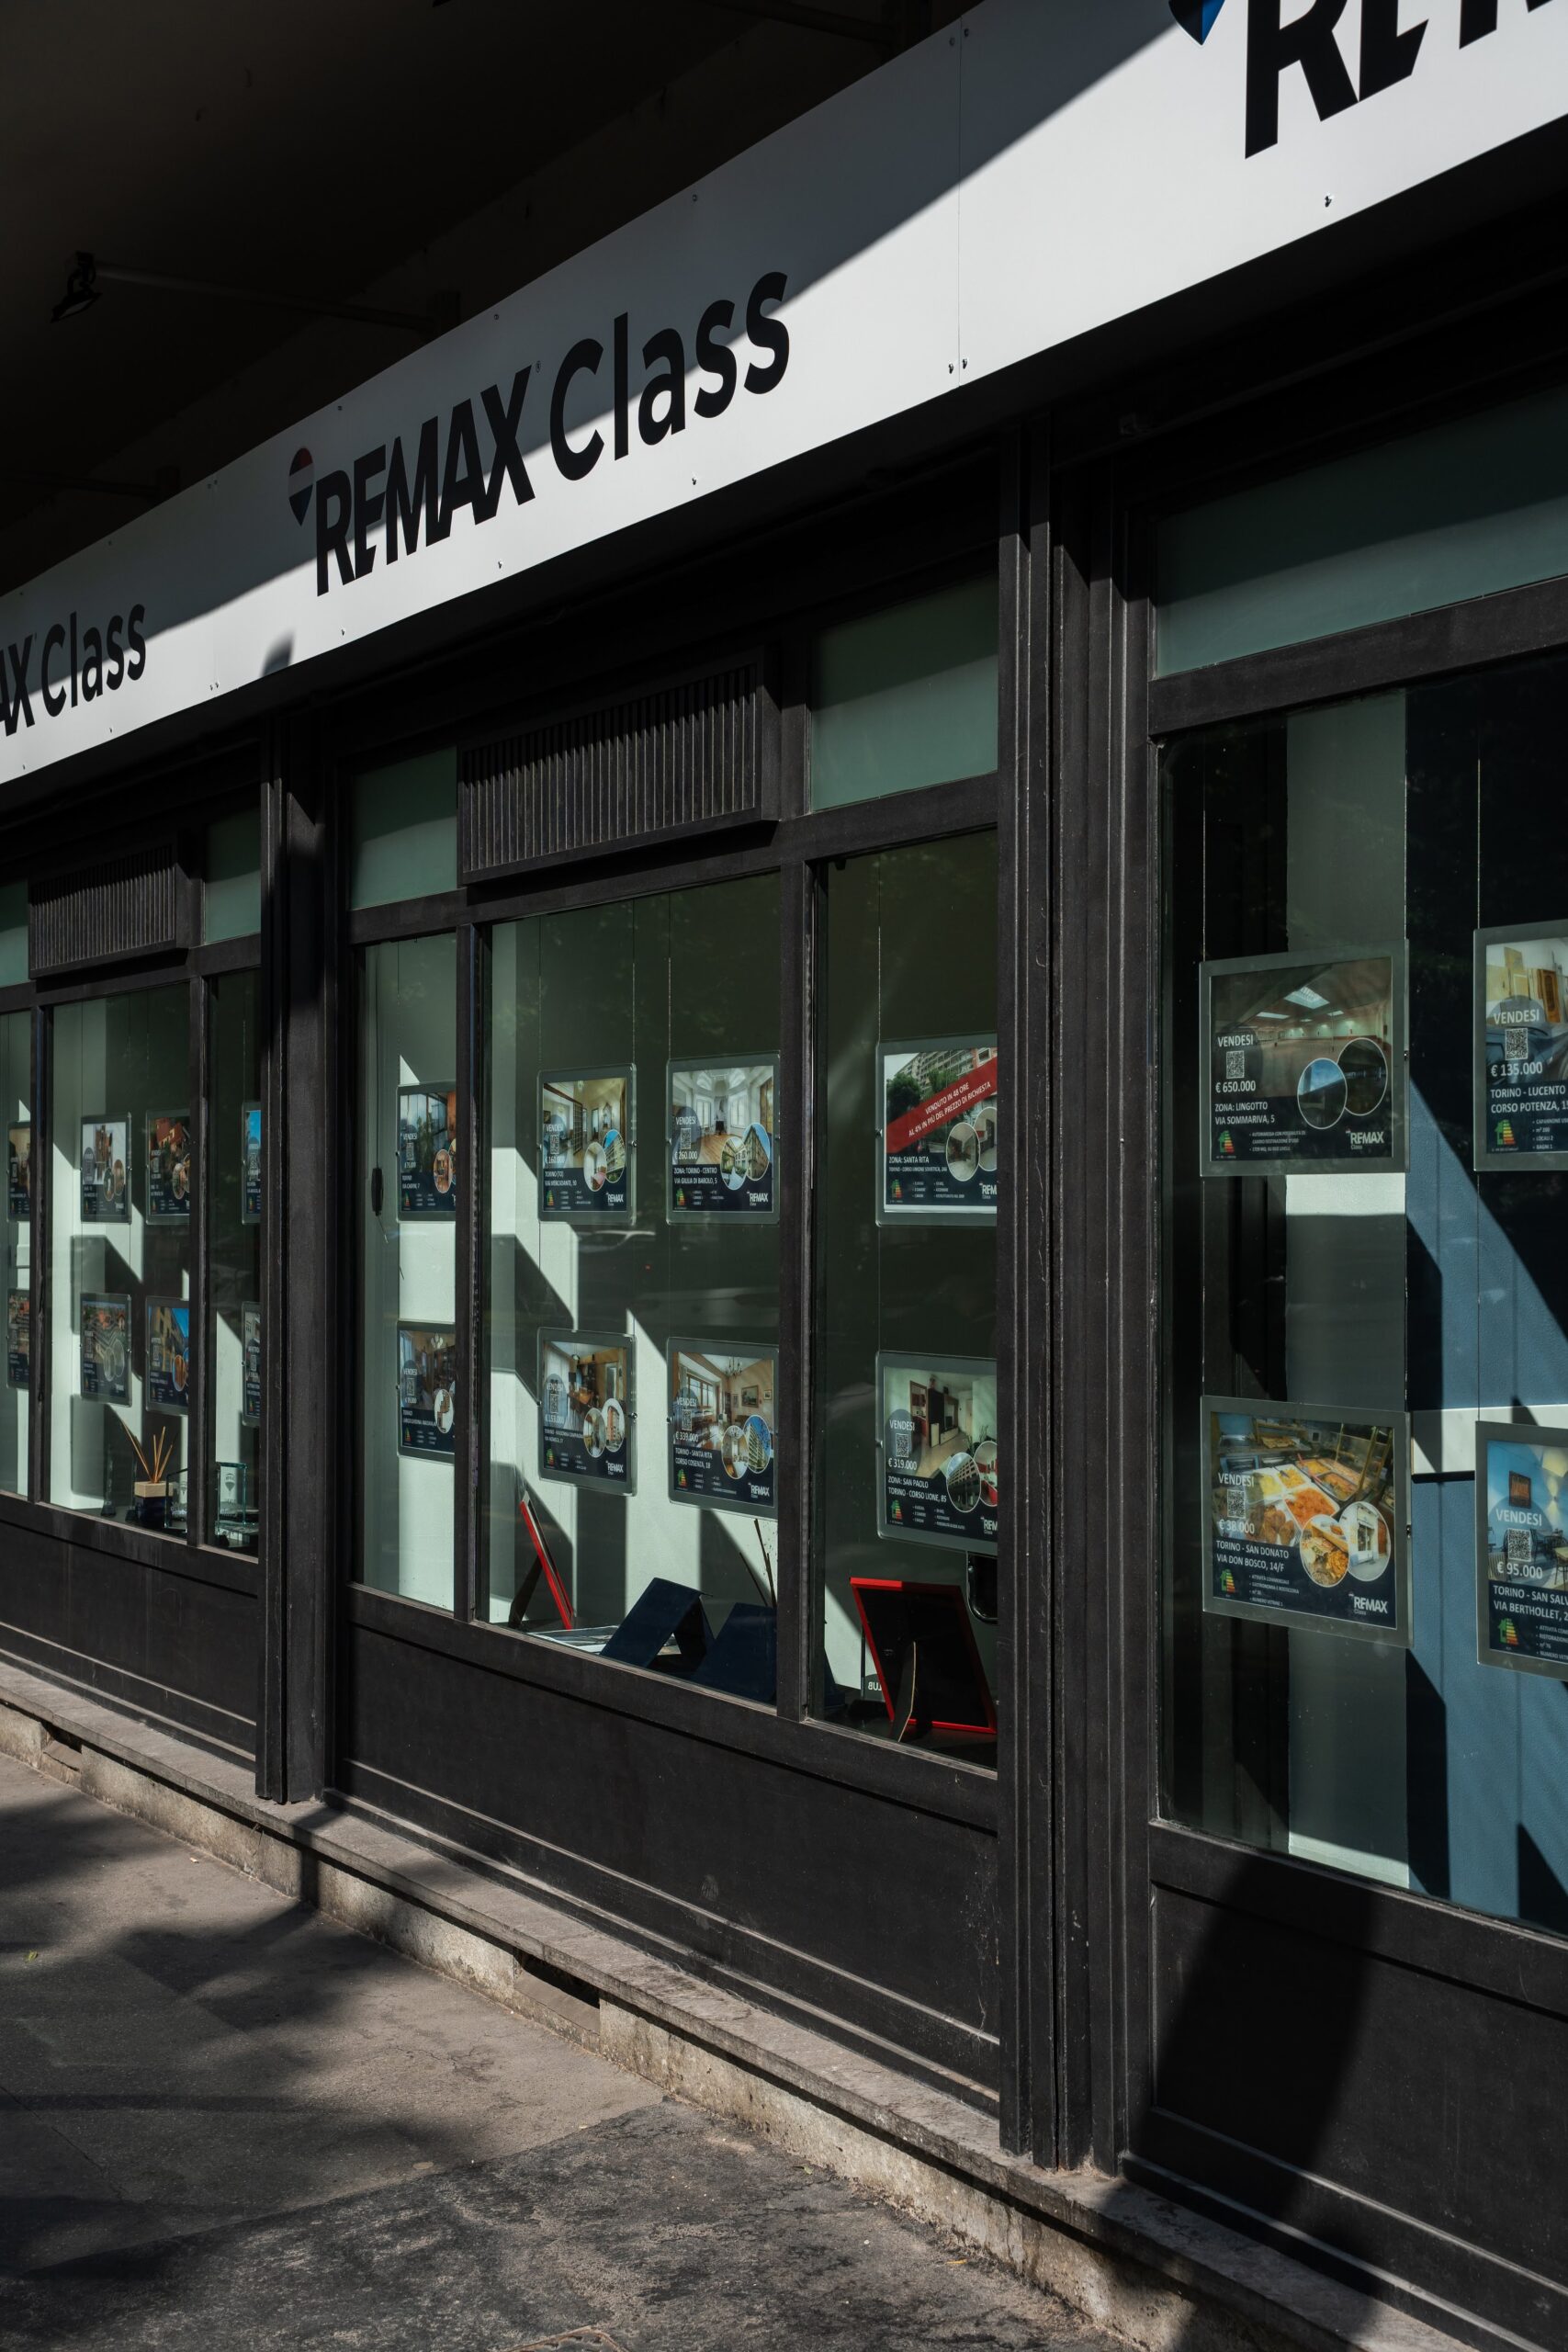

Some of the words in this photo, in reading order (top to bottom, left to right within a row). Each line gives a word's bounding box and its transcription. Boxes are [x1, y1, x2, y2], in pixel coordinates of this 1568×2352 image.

[316, 365, 536, 596] REMAX
[551, 272, 791, 481] Class
[41, 604, 146, 717] Class
[1494, 1010, 1540, 1024] VENDESI
[1217, 1035, 1253, 1047] VENDESI
[1491, 1065, 1498, 1077] €
[1500, 1062, 1543, 1077] 135.000
[1215, 1082, 1222, 1093] €
[1223, 1080, 1256, 1092] 650.000
[1490, 1088, 1521, 1099] TORINO
[1528, 1085, 1565, 1096] LUCENTO
[925, 1097, 947, 1114] VENDUTO
[959, 1082, 969, 1093] ORE
[935, 1110, 944, 1120] DEL
[944, 1099, 961, 1114] PREZZO
[967, 1081, 991, 1101] RICHIESTA
[1214, 1102, 1235, 1112] ZONA:
[1235, 1102, 1268, 1111] LINGOTTO
[1491, 1102, 1517, 1114] CORSO
[1519, 1101, 1560, 1112] POTENZA,
[675, 1116, 696, 1125] VENDESI
[1215, 1115, 1226, 1125] VIA
[1227, 1114, 1269, 1125] SOMMARIVA,
[1270, 1114, 1275, 1123] 5
[1350, 1132, 1384, 1144] REMAX
[679, 1151, 697, 1159] 260.000
[982, 1184, 998, 1195] REM
[607, 1193, 625, 1204] REMAX
[750, 1193, 768, 1203] REMAX
[676, 1397, 696, 1407] VENDESI
[889, 1419, 915, 1431] VENDESI
[607, 1462, 624, 1474] REMAX
[894, 1458, 918, 1471] 319.000
[888, 1476, 902, 1486] ZONA:
[903, 1477, 912, 1487] SAN
[913, 1479, 929, 1488] PAOLO
[1218, 1472, 1254, 1487] VENDESI
[750, 1485, 770, 1498] REMAX
[888, 1487, 906, 1497] TORINO
[908, 1489, 924, 1499] CORSO
[1495, 1509, 1541, 1526] VENDESI
[1226, 1520, 1255, 1534] 38.000
[1216, 1540, 1241, 1552] TORINO
[1246, 1545, 1258, 1555] SAN
[1260, 1546, 1289, 1559] DONATO
[1216, 1554, 1227, 1563] VIA
[1228, 1555, 1244, 1566] DON
[1245, 1558, 1269, 1571] BOSCO,
[1269, 1560, 1284, 1573] 14/F
[1497, 1562, 1504, 1574] €
[1506, 1562, 1543, 1579] 95.000
[1494, 1585, 1525, 1600] TORINO
[1531, 1590, 1549, 1603] SAN
[1354, 1596, 1388, 1613] REMAX
[1494, 1600, 1507, 1611] VIA
[1509, 1602, 1562, 1622] BERTHOLLET,
